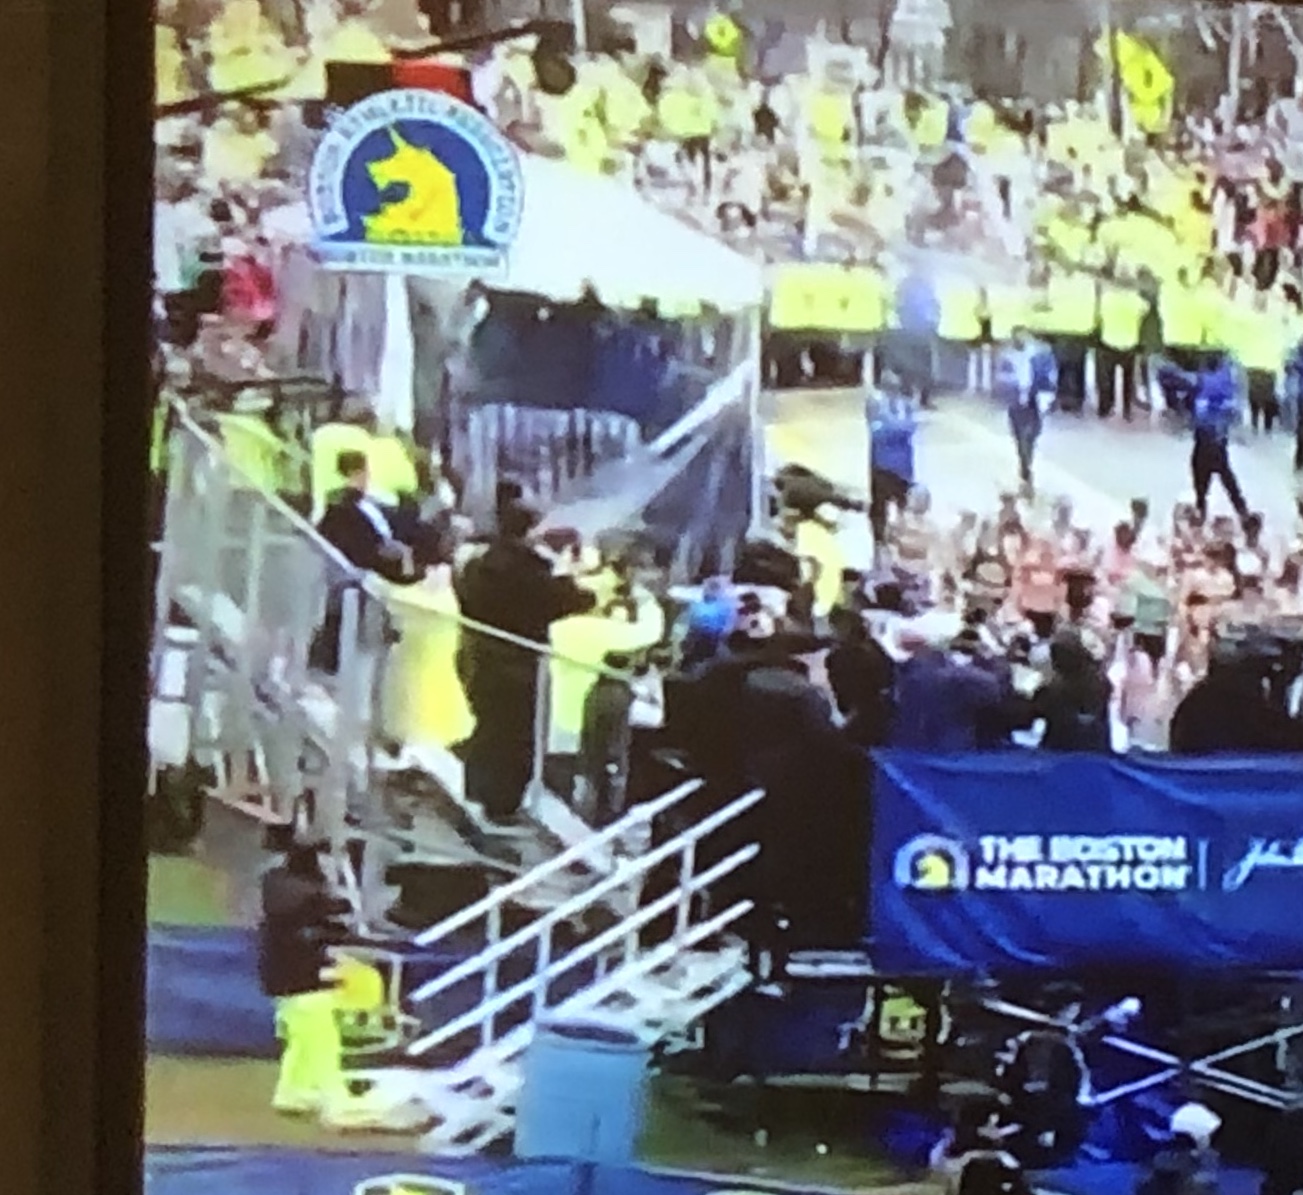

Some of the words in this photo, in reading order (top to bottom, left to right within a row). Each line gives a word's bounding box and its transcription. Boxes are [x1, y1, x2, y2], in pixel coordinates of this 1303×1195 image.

[979, 834, 1042, 862] THE
[1049, 835, 1187, 863] BOSTON
[974, 863, 1191, 891] MARATHON
